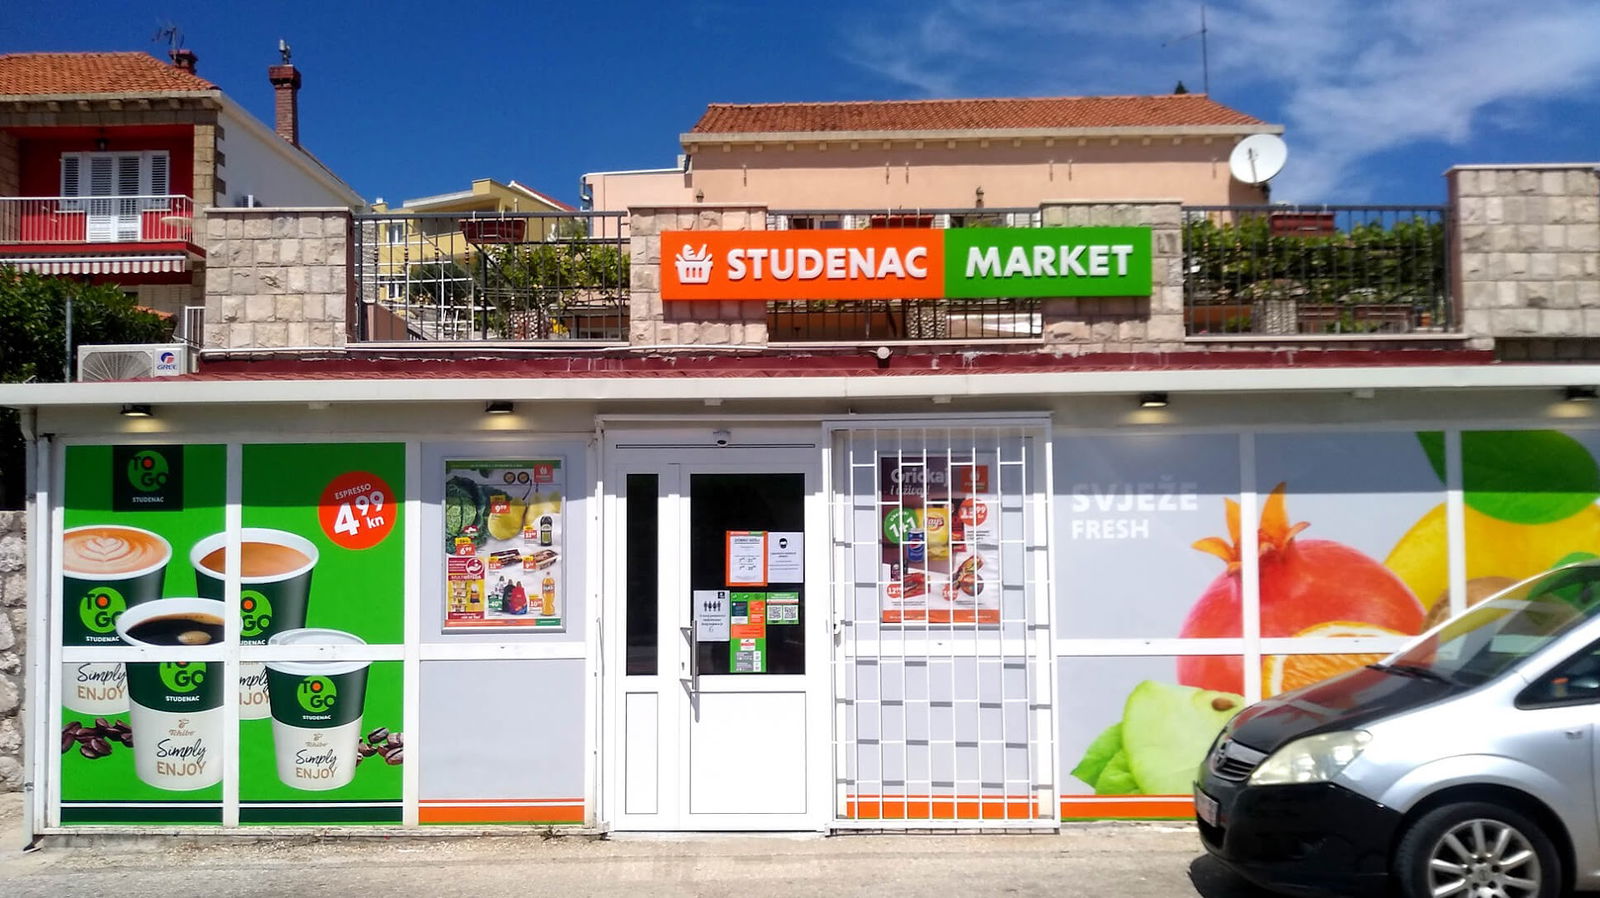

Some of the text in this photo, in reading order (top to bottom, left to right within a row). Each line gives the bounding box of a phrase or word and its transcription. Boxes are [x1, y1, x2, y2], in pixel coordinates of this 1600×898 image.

[727, 244, 1134, 281] STUDENAC MARKET
[130, 456, 156, 471] TO
[141, 472, 168, 487] GO
[334, 483, 372, 500] ESPRESSO
[1072, 474, 1198, 513] SVJEŽE
[366, 516, 385, 529] kn
[1072, 519, 1149, 539] FRESH
[83, 593, 111, 610] TO
[242, 614, 272, 631] GO
[77, 663, 127, 689] Simply
[174, 670, 206, 687] GO
[77, 685, 126, 700] ENJOY
[300, 680, 324, 693] TO
[310, 695, 337, 708] GO
[156, 738, 207, 764] Simply
[296, 749, 337, 769] Simply
[157, 761, 207, 776] ENJOY
[296, 767, 337, 779] ENJOY
